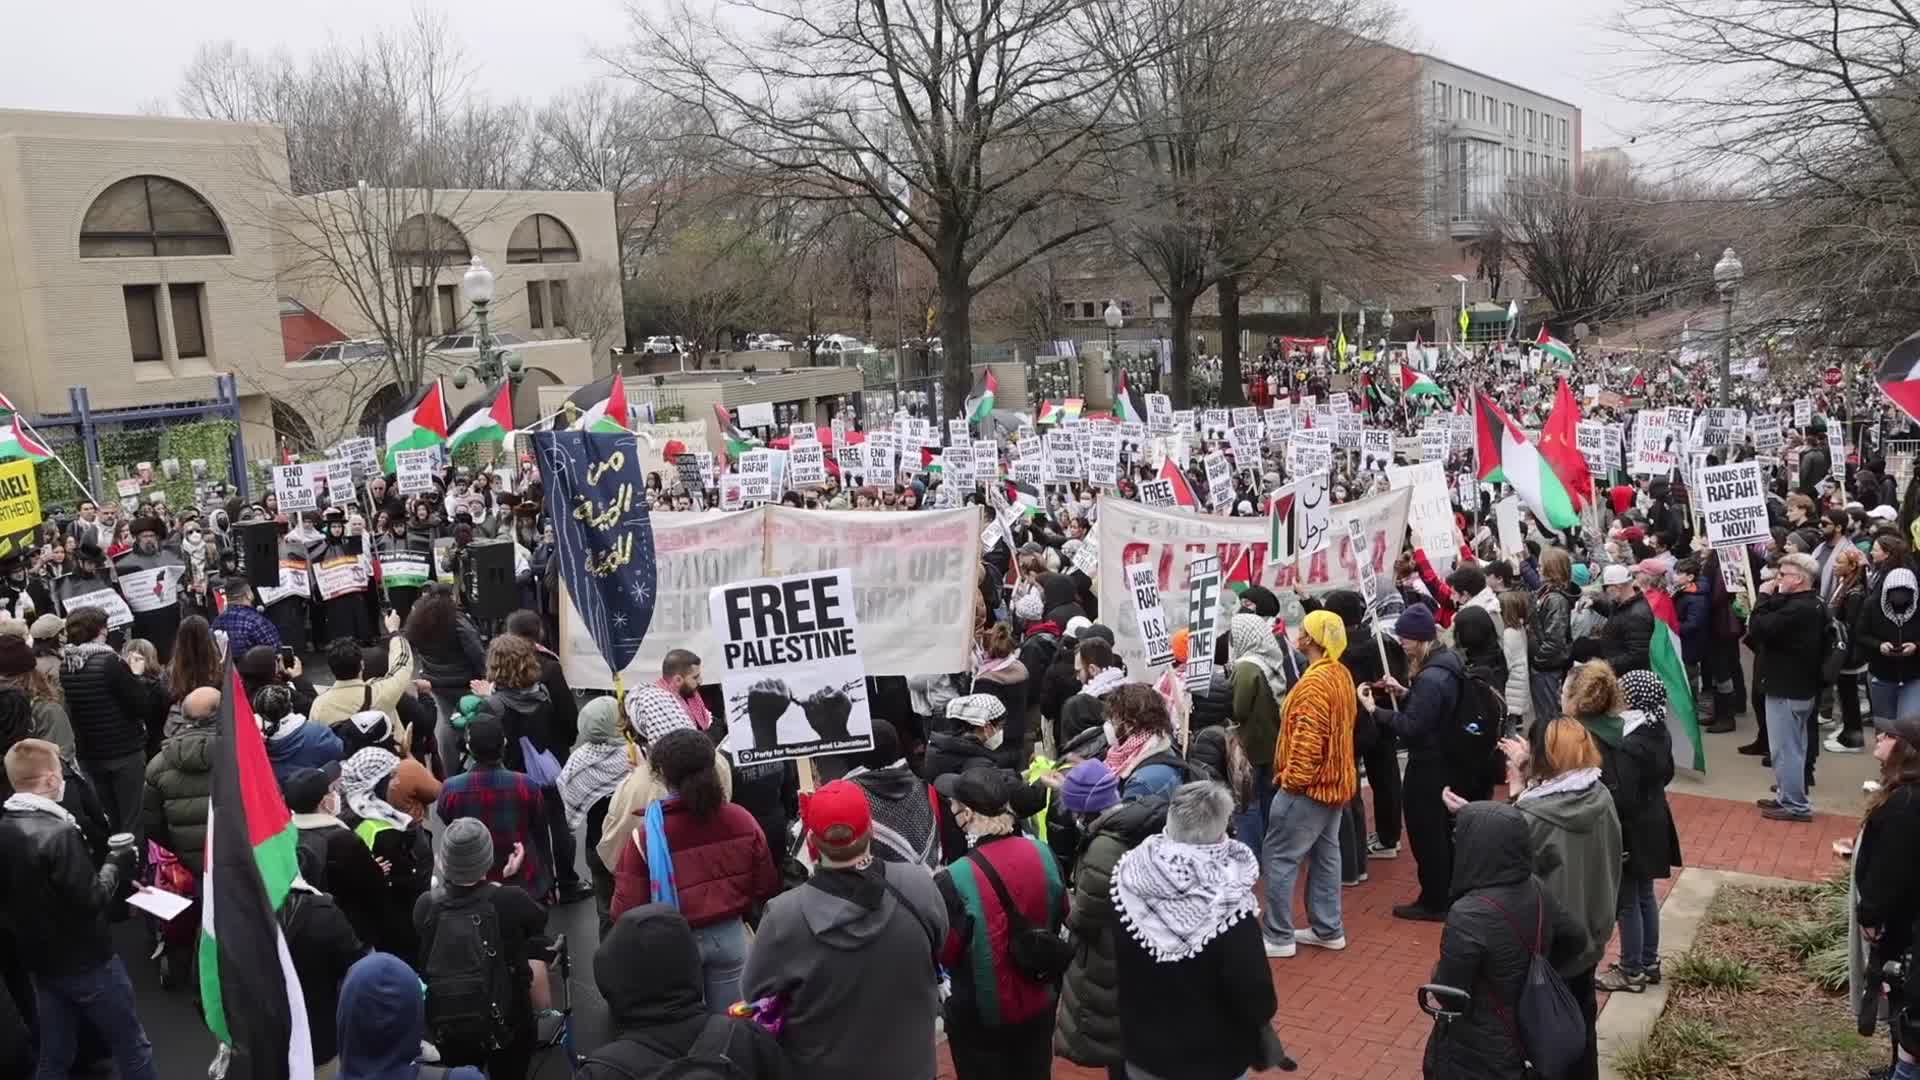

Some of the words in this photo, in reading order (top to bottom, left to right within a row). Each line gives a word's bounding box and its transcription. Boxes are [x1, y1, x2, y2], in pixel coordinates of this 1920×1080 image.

[1151, 396, 1164, 404] END
[1207, 411, 1226, 420] FREE
[1644, 416, 1665, 426] SEN
[1668, 409, 1690, 424] FREE
[1366, 432, 1389, 445] FREE
[1704, 433, 1729, 446] NOW!
[1643, 440, 1660, 450] NOT
[793, 453, 820, 464] RAFAH!
[839, 448, 860, 460] FREE
[870, 448, 886, 458] END
[742, 462, 768, 472] RAFAH!
[872, 458, 886, 467] ALL
[283, 466, 303, 478] END
[1704, 469, 1739, 485] HANDS
[1740, 467, 1756, 480] OFF
[0, 474, 31, 501] AEL!
[286, 478, 303, 488] ALL
[280, 490, 296, 500] U.S.
[298, 488, 312, 498] AID
[1143, 481, 1172, 501] FREE
[1706, 480, 1758, 502] RAFAH!
[1709, 505, 1766, 524] CEASEFIRE
[1722, 520, 1756, 538] NOW!
[725, 576, 845, 641] FREE
[725, 628, 857, 669] PALESTINE
[754, 750, 772, 758] Party
[785, 746, 818, 754] Socialism
[834, 739, 869, 748] Liberation
